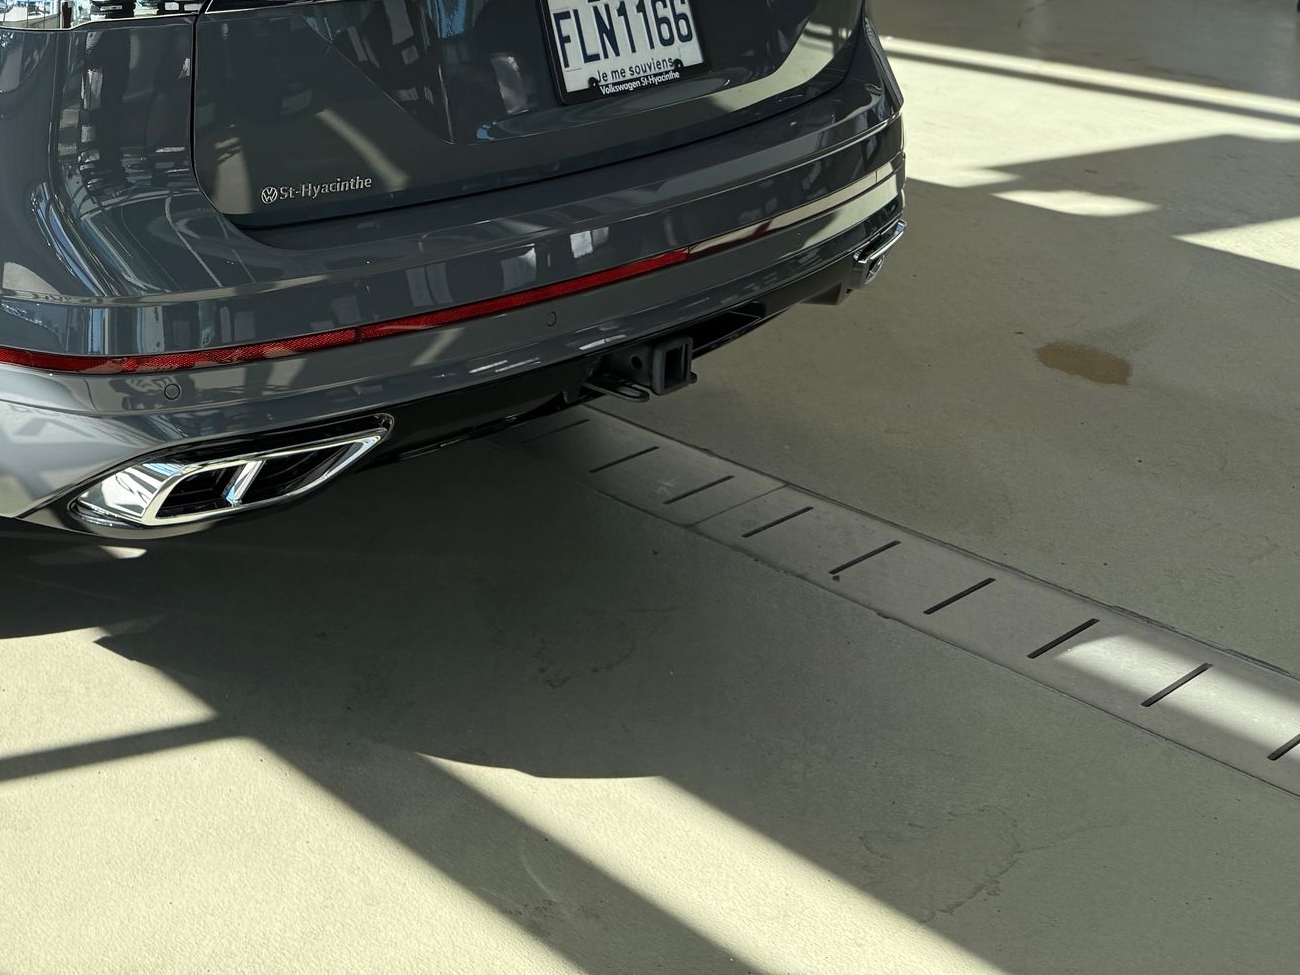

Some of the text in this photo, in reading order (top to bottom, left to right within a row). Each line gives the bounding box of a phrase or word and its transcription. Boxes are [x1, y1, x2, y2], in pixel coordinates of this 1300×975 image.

[611, 68, 626, 81] me
[628, 57, 674, 77] souviens
[600, 70, 680, 95] Volkswagen St-Hyacinthe
[279, 176, 372, 200] St-Hyacinthe
